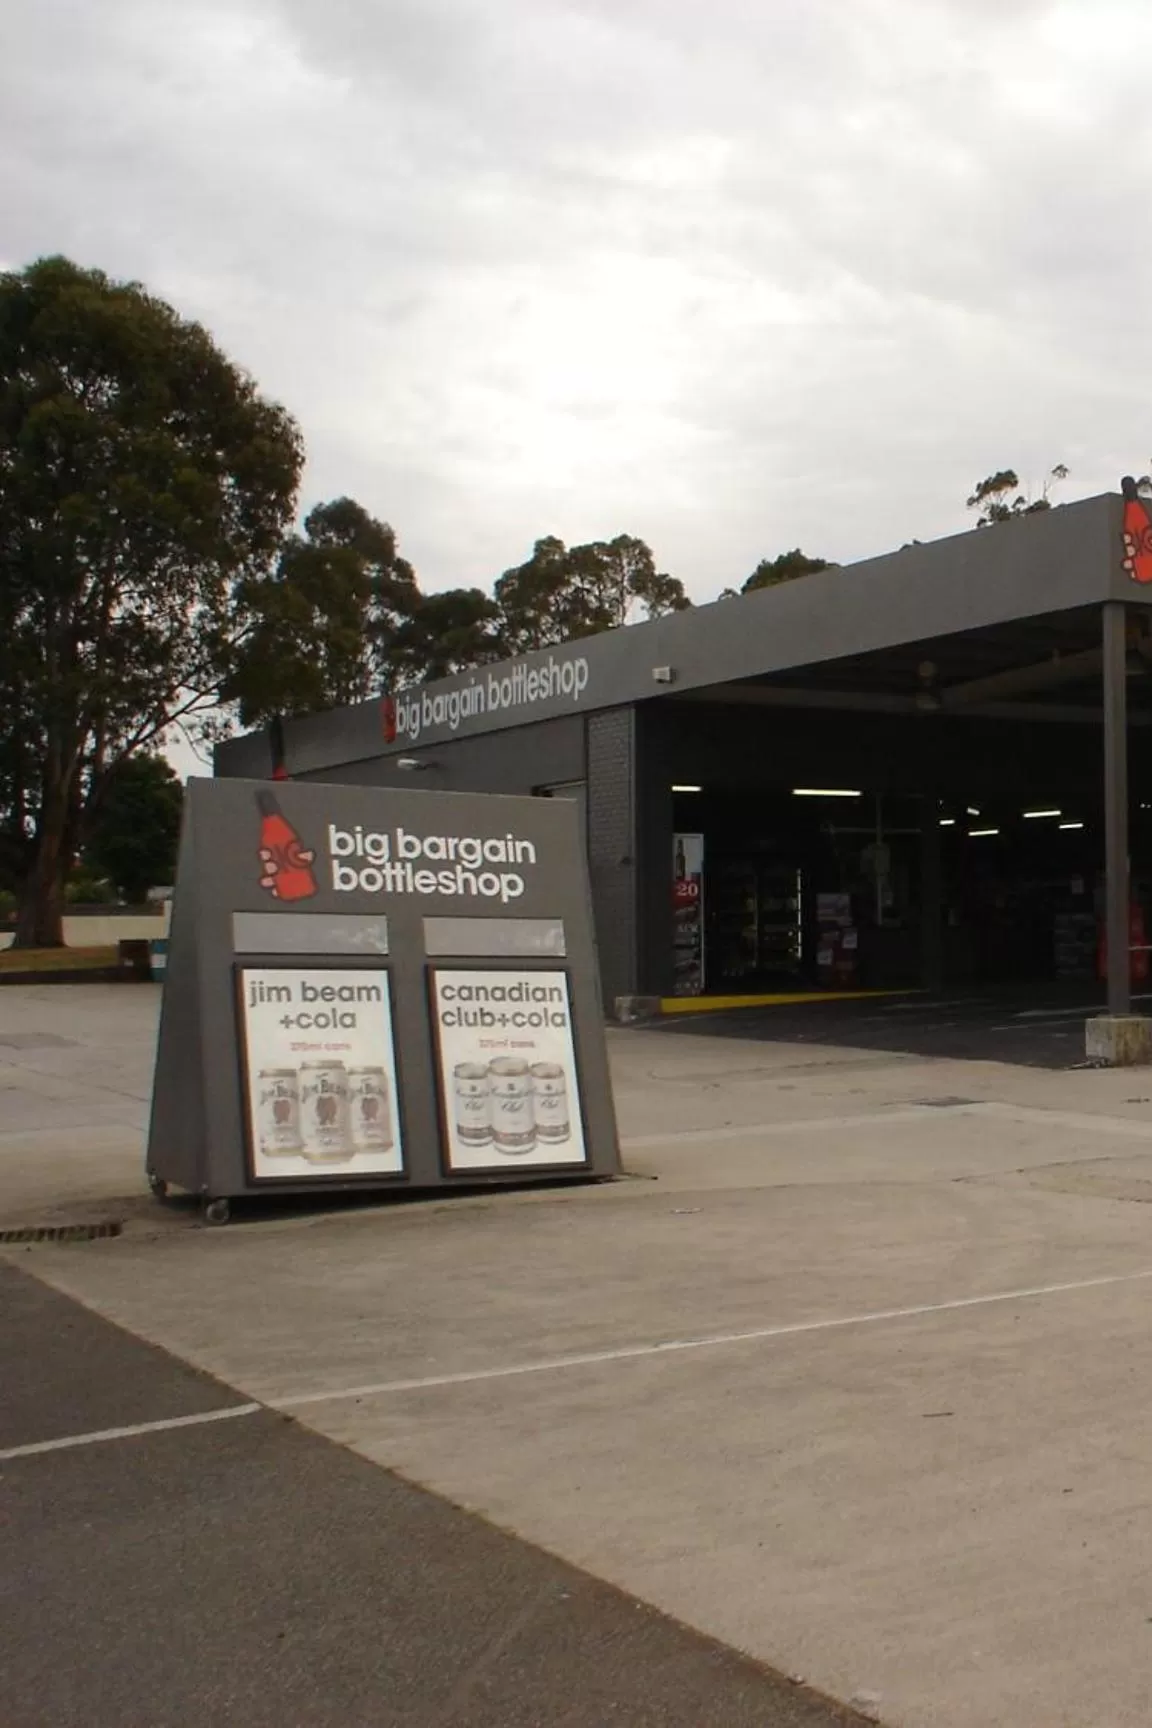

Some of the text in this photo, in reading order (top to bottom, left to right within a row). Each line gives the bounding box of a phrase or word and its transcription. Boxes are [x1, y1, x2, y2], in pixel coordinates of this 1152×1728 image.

[395, 655, 588, 740] big bargain bottleshop
[328, 824, 536, 869] big bargain
[331, 860, 525, 902] bottleshop
[675, 883, 698, 897] 20
[248, 981, 381, 1008] jim beam
[440, 981, 563, 1003] canadian
[279, 1008, 357, 1030] +cola
[441, 1007, 566, 1030] club+cola
